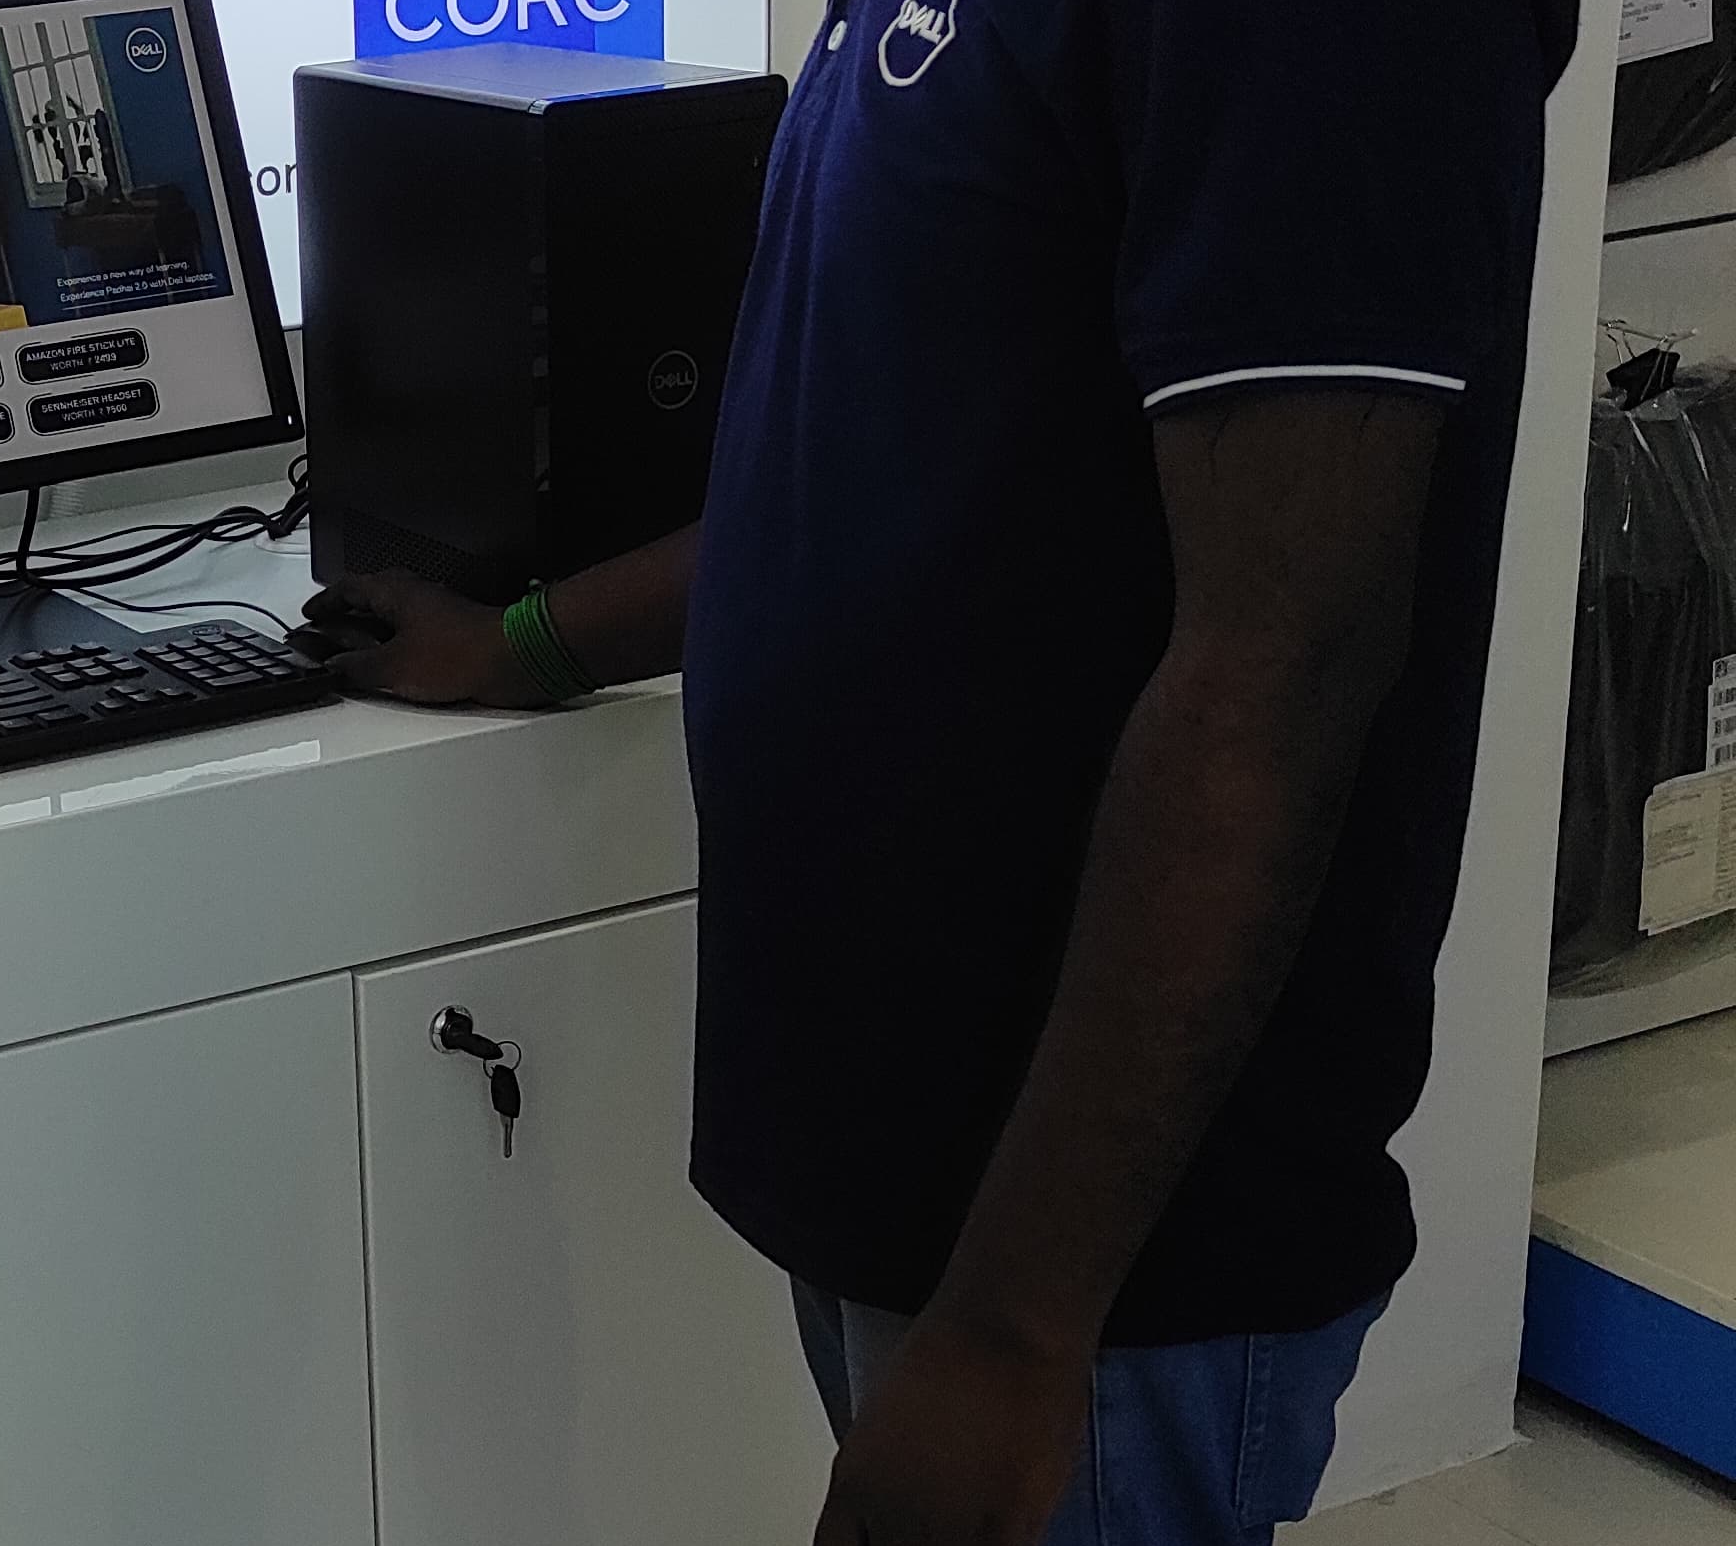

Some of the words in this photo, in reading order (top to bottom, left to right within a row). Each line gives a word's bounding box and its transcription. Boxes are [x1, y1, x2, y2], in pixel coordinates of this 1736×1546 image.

[898, 0, 946, 45] DELL
[131, 43, 162, 57] DELL
[25, 347, 66, 361] AMAZON
[65, 343, 87, 356] FIRE
[87, 339, 116, 352] STICK
[115, 336, 136, 348] LITE
[655, 370, 693, 390] DELL
[100, 388, 141, 403] HEADSET
